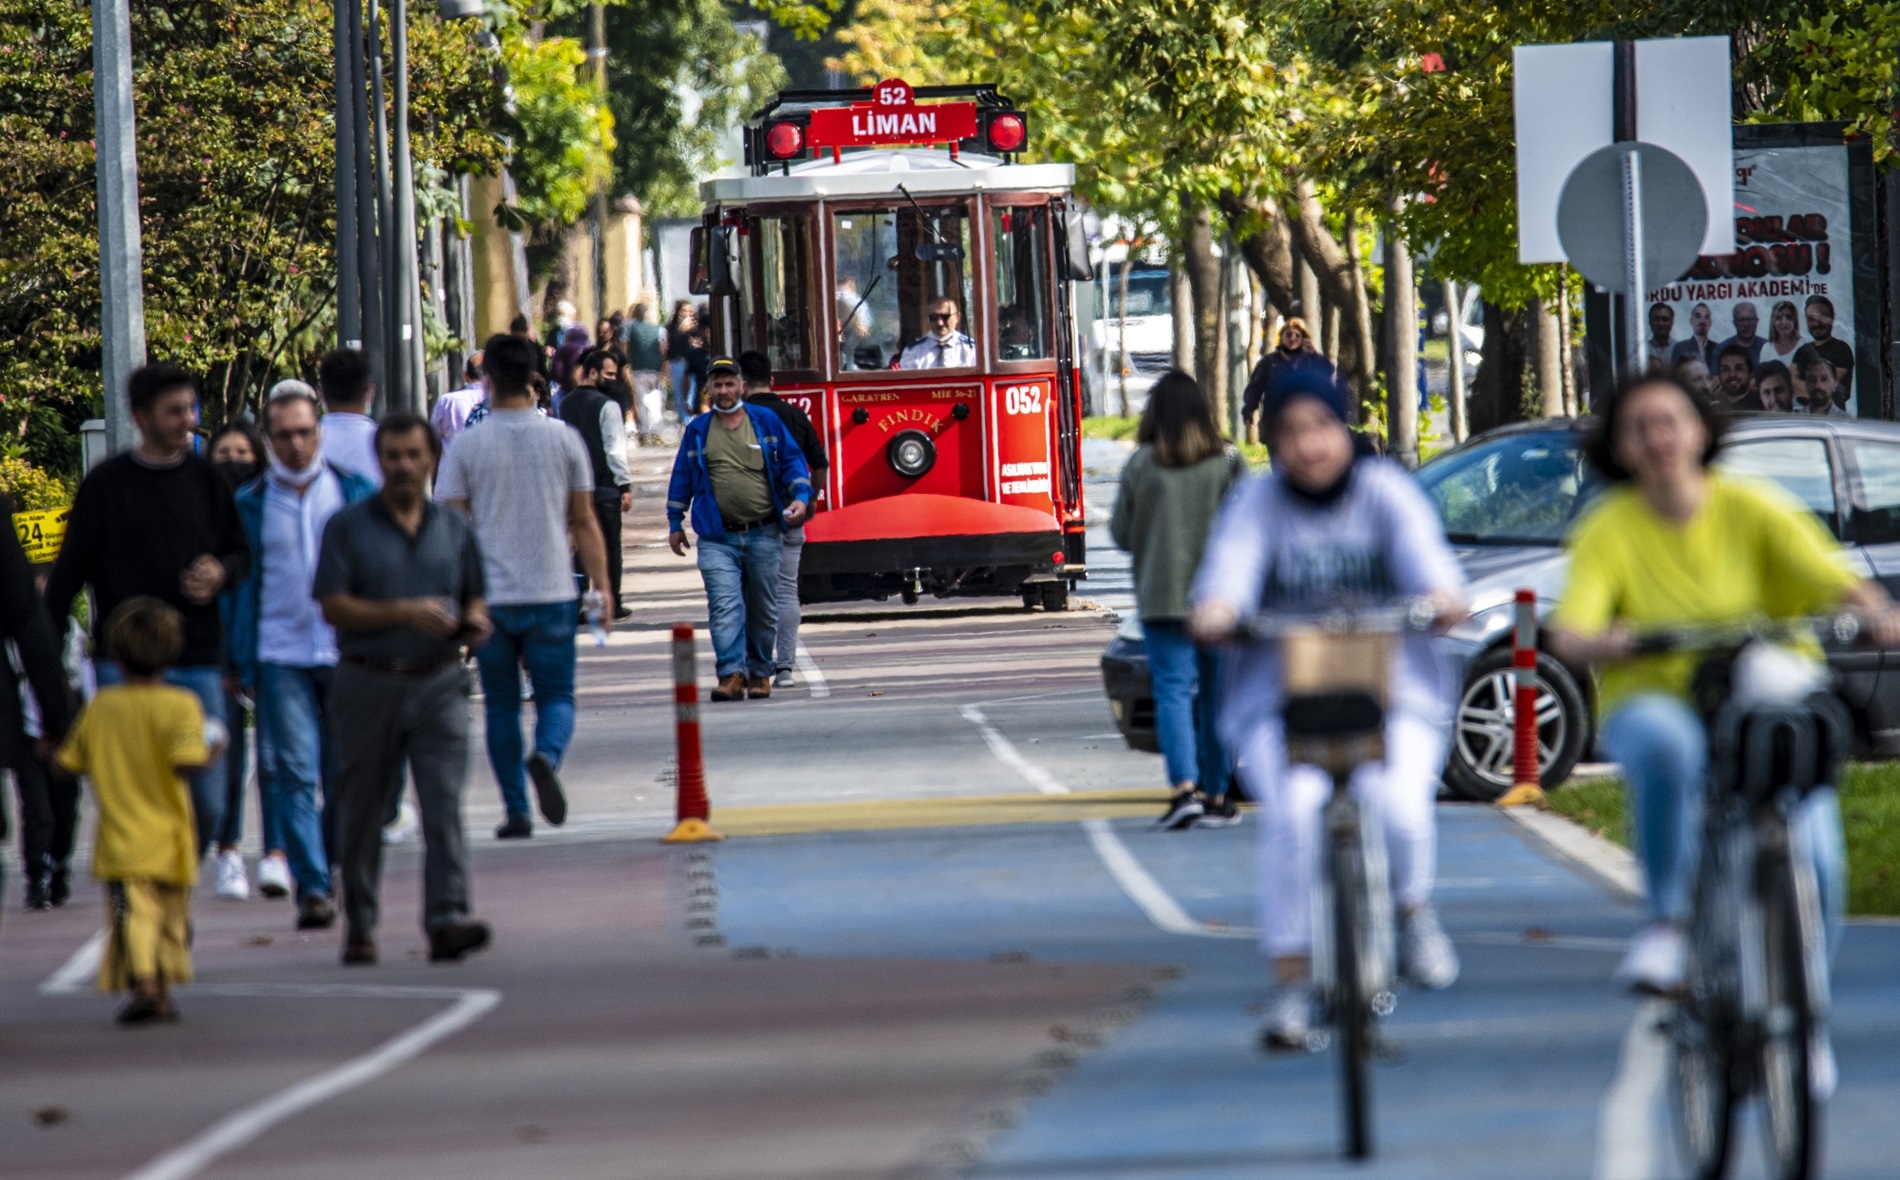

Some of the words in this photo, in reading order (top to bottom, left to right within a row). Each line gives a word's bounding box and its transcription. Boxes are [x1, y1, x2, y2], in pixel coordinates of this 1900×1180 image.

[879, 87, 906, 105] 52
[852, 110, 936, 136] LİMAN
[1686, 282, 1733, 300] YARGI
[1005, 385, 1042, 415] 052
[878, 409, 944, 432] FINDIK
[19, 522, 43, 545] 24
